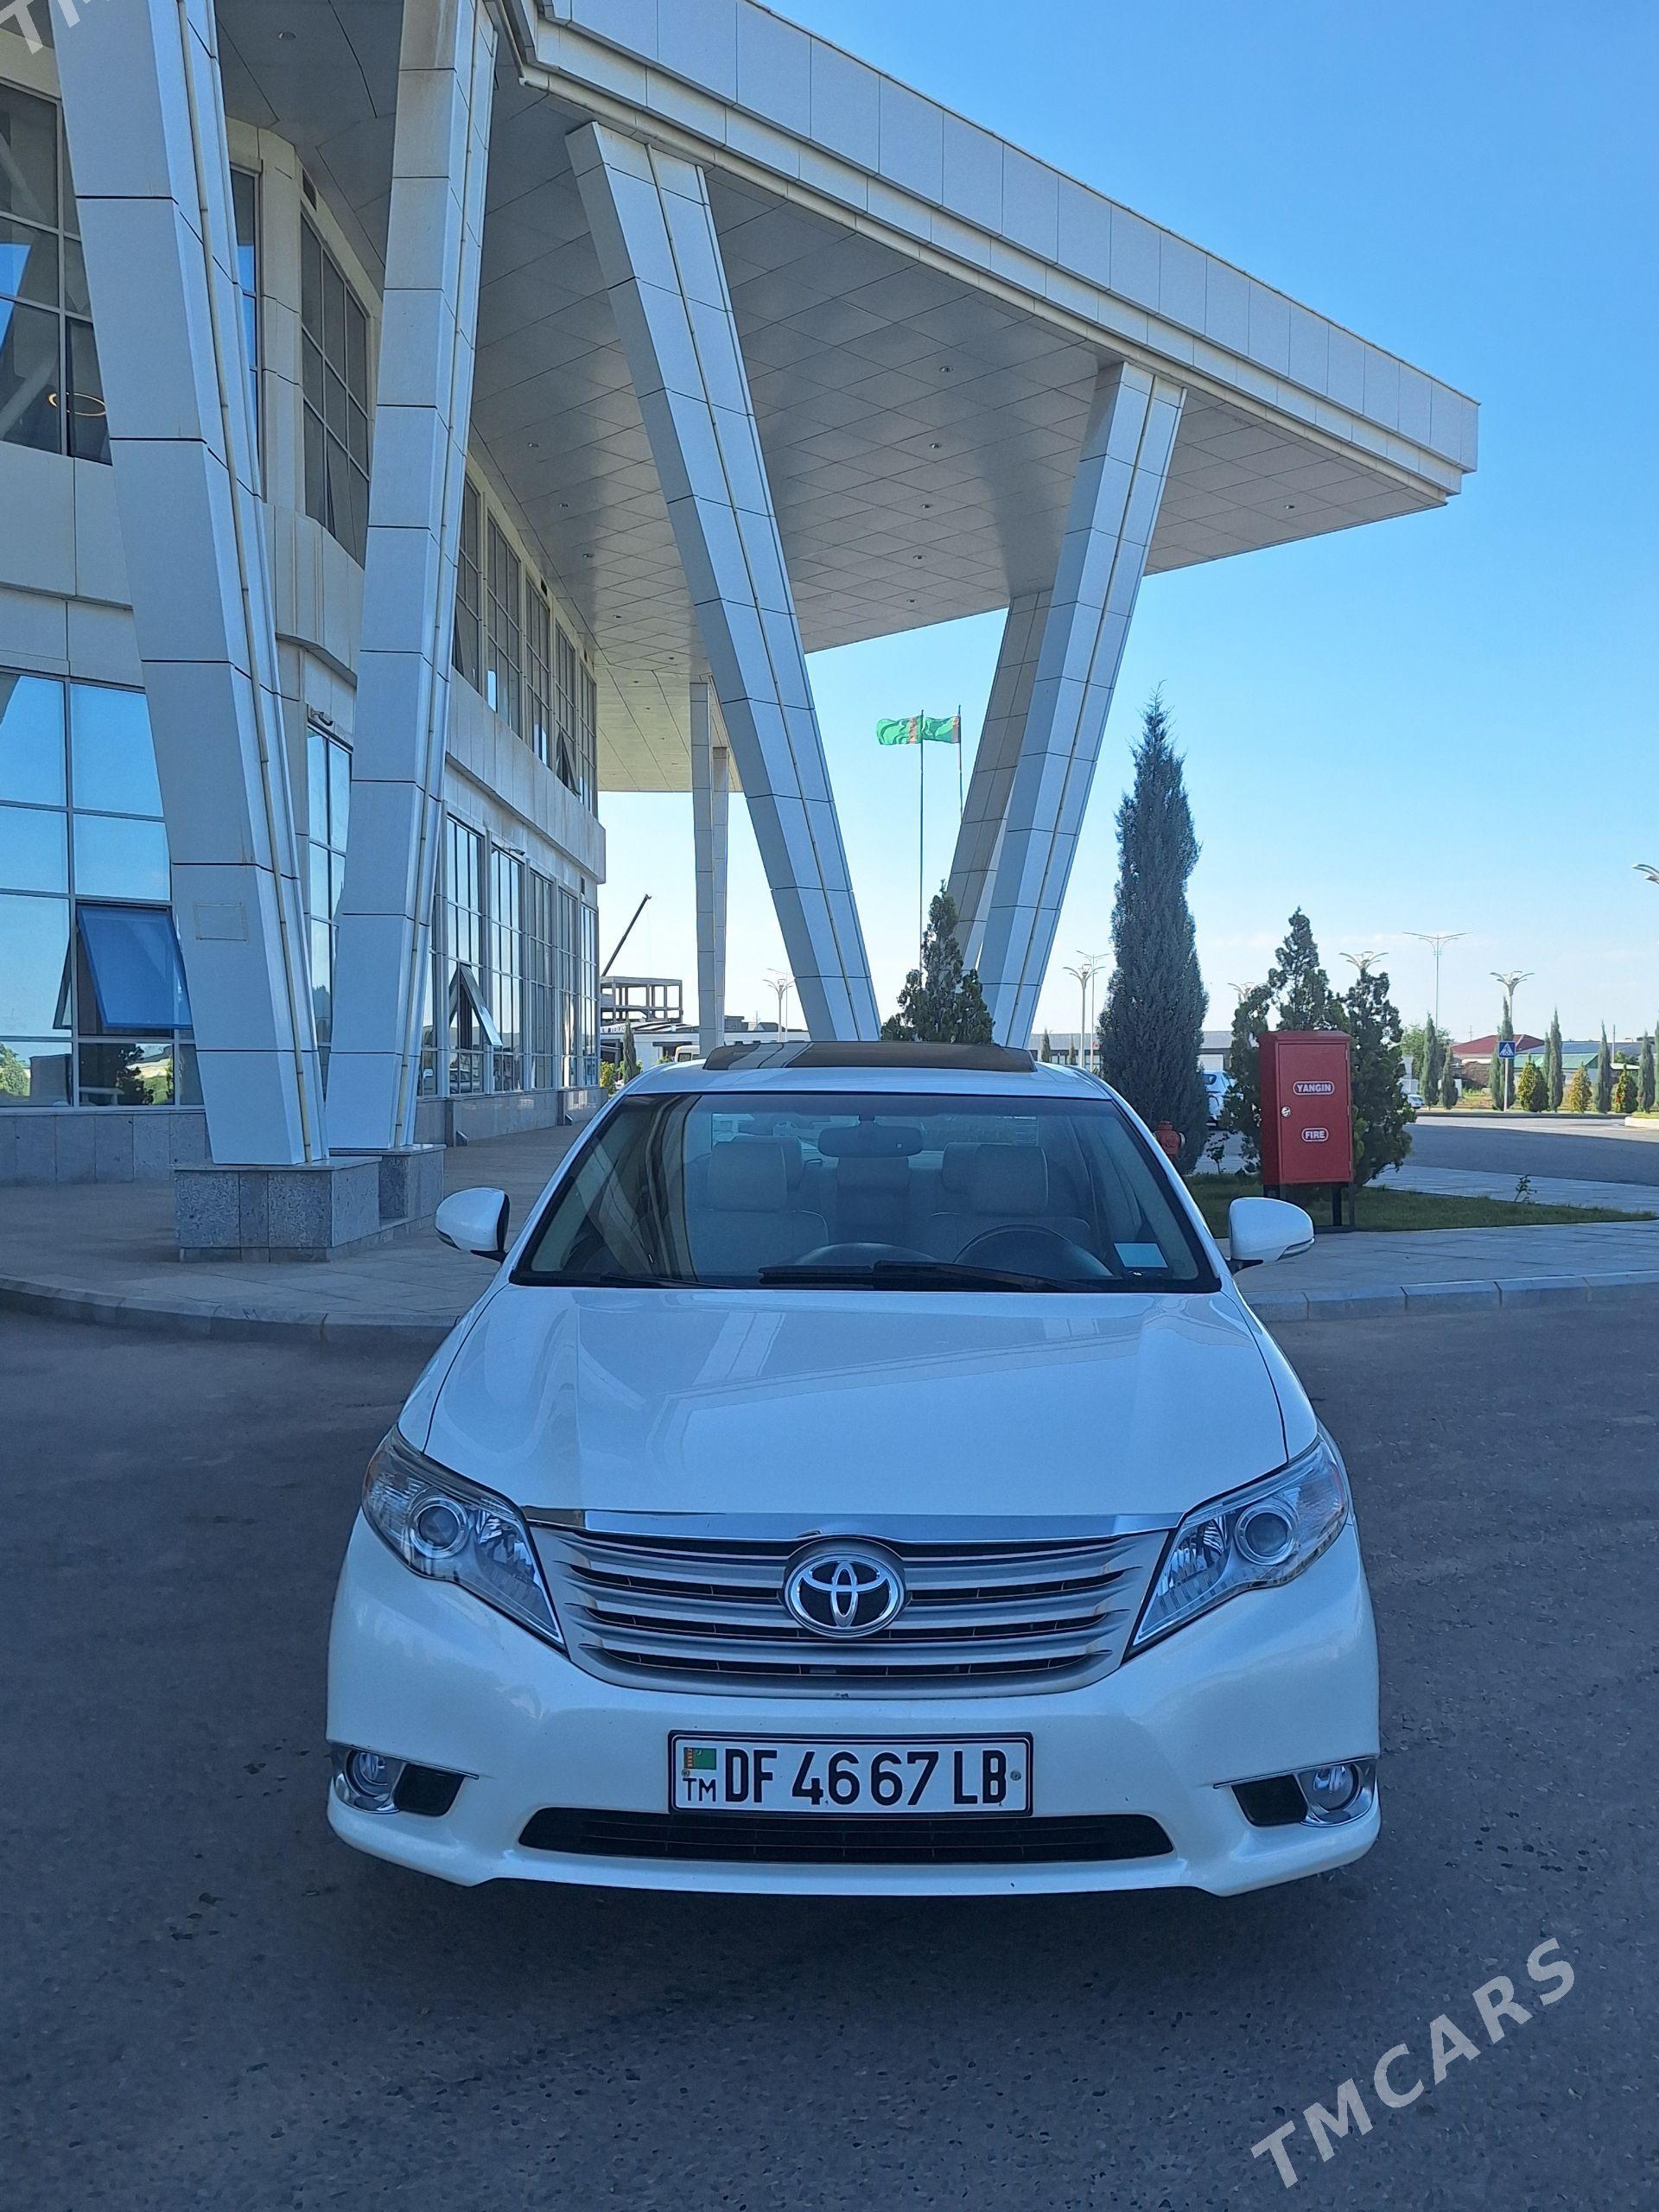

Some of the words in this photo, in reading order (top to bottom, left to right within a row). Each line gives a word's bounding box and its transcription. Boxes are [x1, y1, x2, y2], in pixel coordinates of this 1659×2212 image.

[1296, 1084, 1332, 1093] YANGIN
[1305, 1130, 1325, 1140] FIRE
[725, 1748, 778, 1803] DF
[791, 1750, 939, 1806] 4667
[953, 1749, 1007, 1804] LB
[682, 1777, 716, 1802] TM
